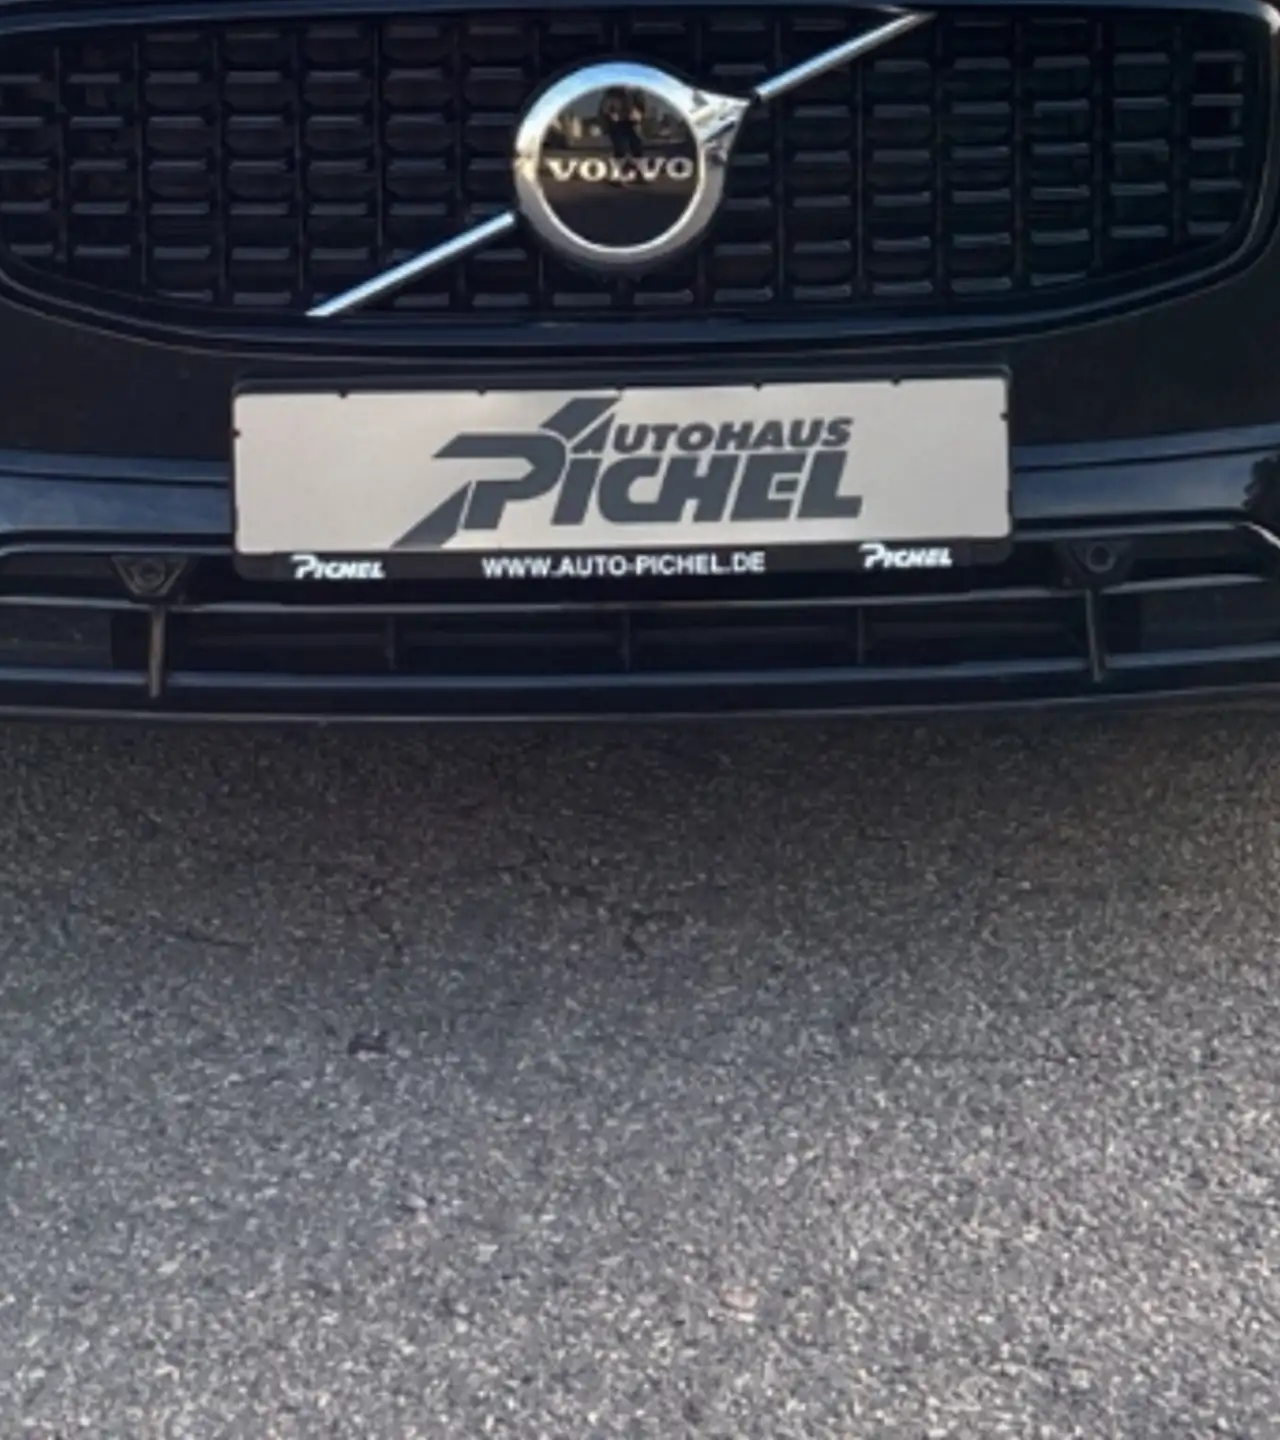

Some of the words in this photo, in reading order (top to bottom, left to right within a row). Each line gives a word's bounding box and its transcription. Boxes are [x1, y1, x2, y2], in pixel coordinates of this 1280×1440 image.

[547, 158, 694, 182] VOLVO
[572, 412, 853, 455] AUTOHAUS
[433, 432, 863, 531] PICHEL
[291, 554, 386, 580] PICHEL
[481, 550, 766, 578] WWW.AUTO-PICHEL.DE
[860, 543, 952, 570] PICHEL
